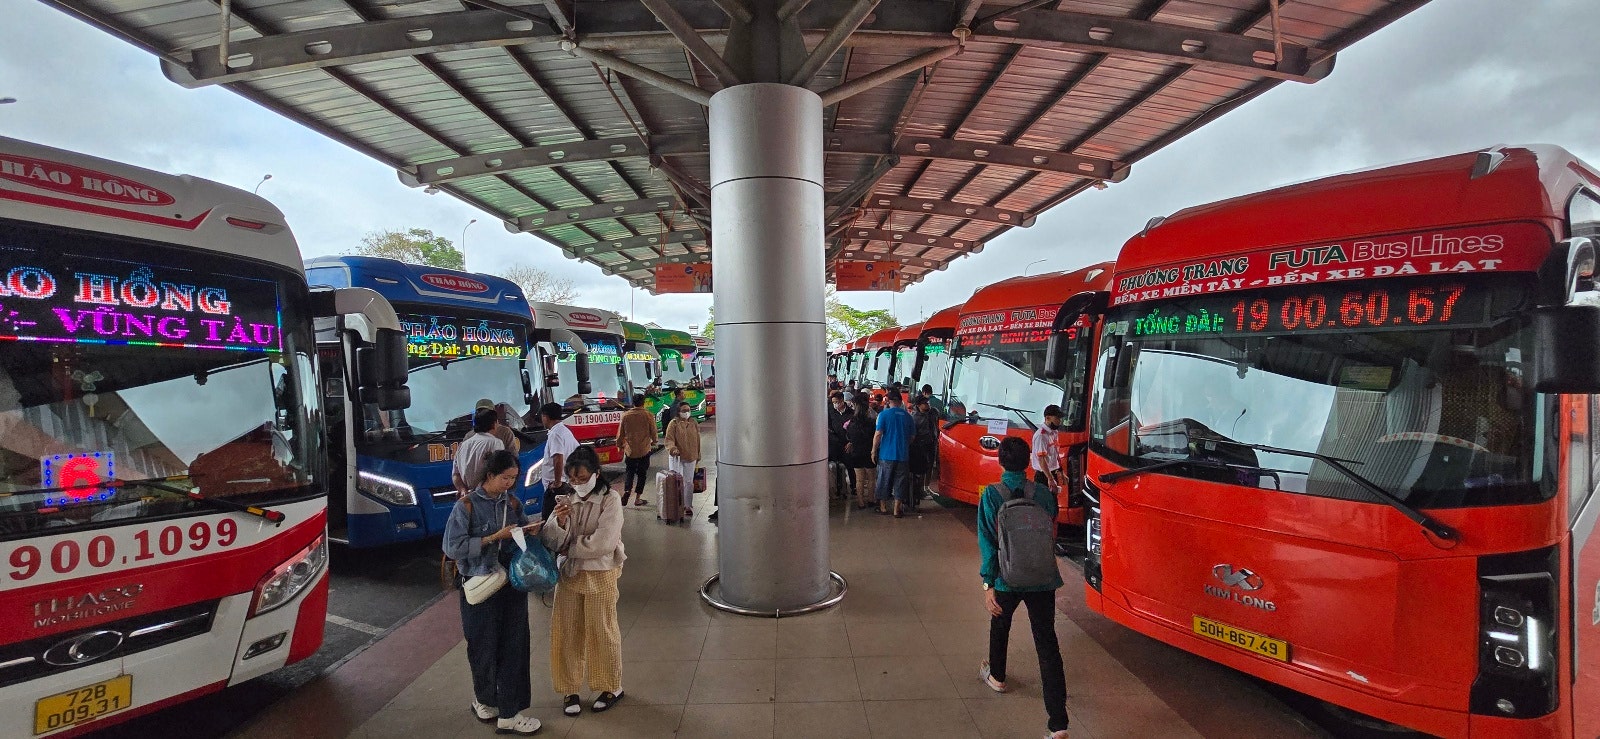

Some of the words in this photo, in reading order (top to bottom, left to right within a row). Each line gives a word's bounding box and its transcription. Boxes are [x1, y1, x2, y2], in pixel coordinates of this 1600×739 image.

[1182, 256, 1250, 282] TRANG
[1268, 244, 1348, 271] FUTA
[1352, 241, 1408, 262] Bus
[1411, 234, 1503, 257] Lines
[0, 266, 56, 299] O
[1114, 290, 1138, 305] BẾN
[1141, 289, 1159, 300] XE
[1162, 280, 1202, 297] MIỀN
[1206, 278, 1245, 293] TÂY
[1267, 269, 1320, 286] BẾN
[1326, 267, 1365, 280] XE
[1372, 261, 1419, 276] ĐÀ
[1429, 258, 1502, 273] LẠT
[52, 305, 190, 338] VŨNG
[200, 316, 275, 344] TÀU
[1011, 310, 1037, 321] FUTA
[1038, 308, 1057, 320] Bus
[1035, 319, 1054, 327] BÌNH
[465, 344, 522, 357] 19001099
[982, 437, 999, 448] KIA
[59, 456, 101, 499] 6
[33, 584, 143, 617] THACO
[1204, 584, 1230, 601] KIM
[1234, 592, 1276, 612] LONG
[1200, 621, 1278, 656] 50H-867.49
[66, 684, 107, 706] 72B
[47, 695, 120, 729] 009.31
